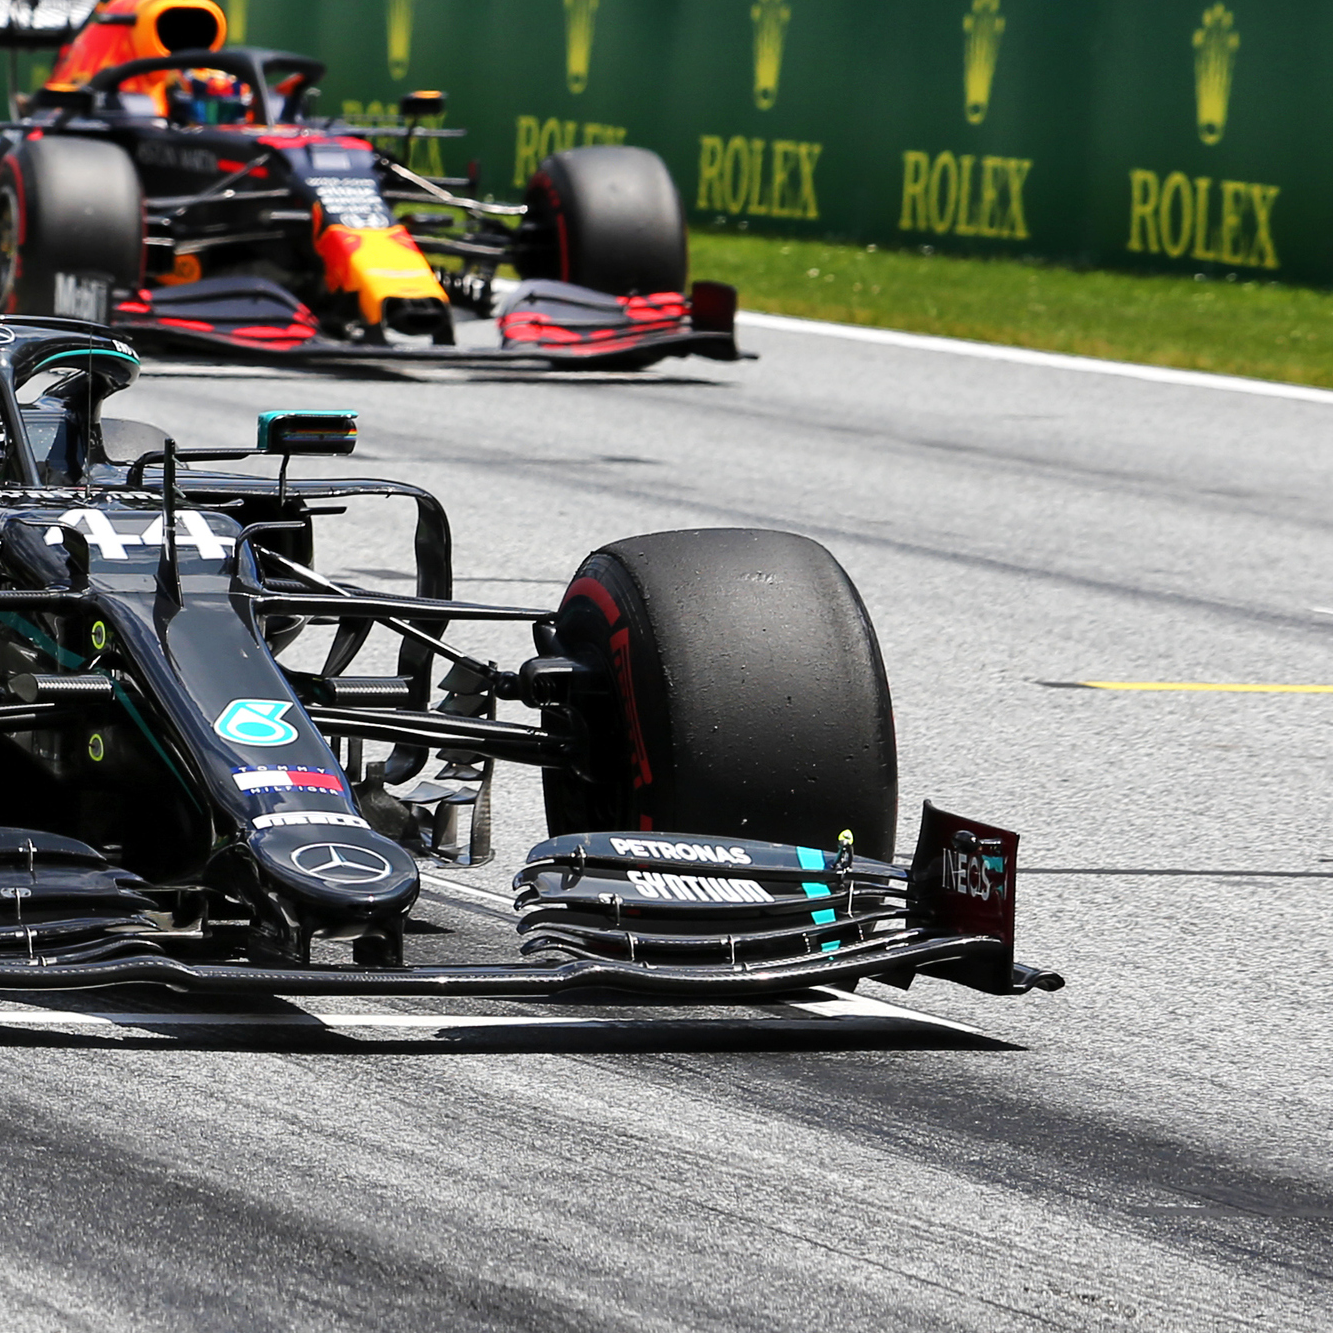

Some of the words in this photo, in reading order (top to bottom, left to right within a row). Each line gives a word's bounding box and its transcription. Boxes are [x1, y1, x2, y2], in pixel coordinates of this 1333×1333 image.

[699, 136, 822, 220] ROLEX
[900, 151, 1032, 239] ROLEX
[1129, 169, 1280, 268] ROLEX
[43, 509, 237, 560] 44
[238, 766, 326, 774] TOMMY
[250, 786, 339, 796] HILFIGER
[609, 837, 753, 864] PETRONAS
